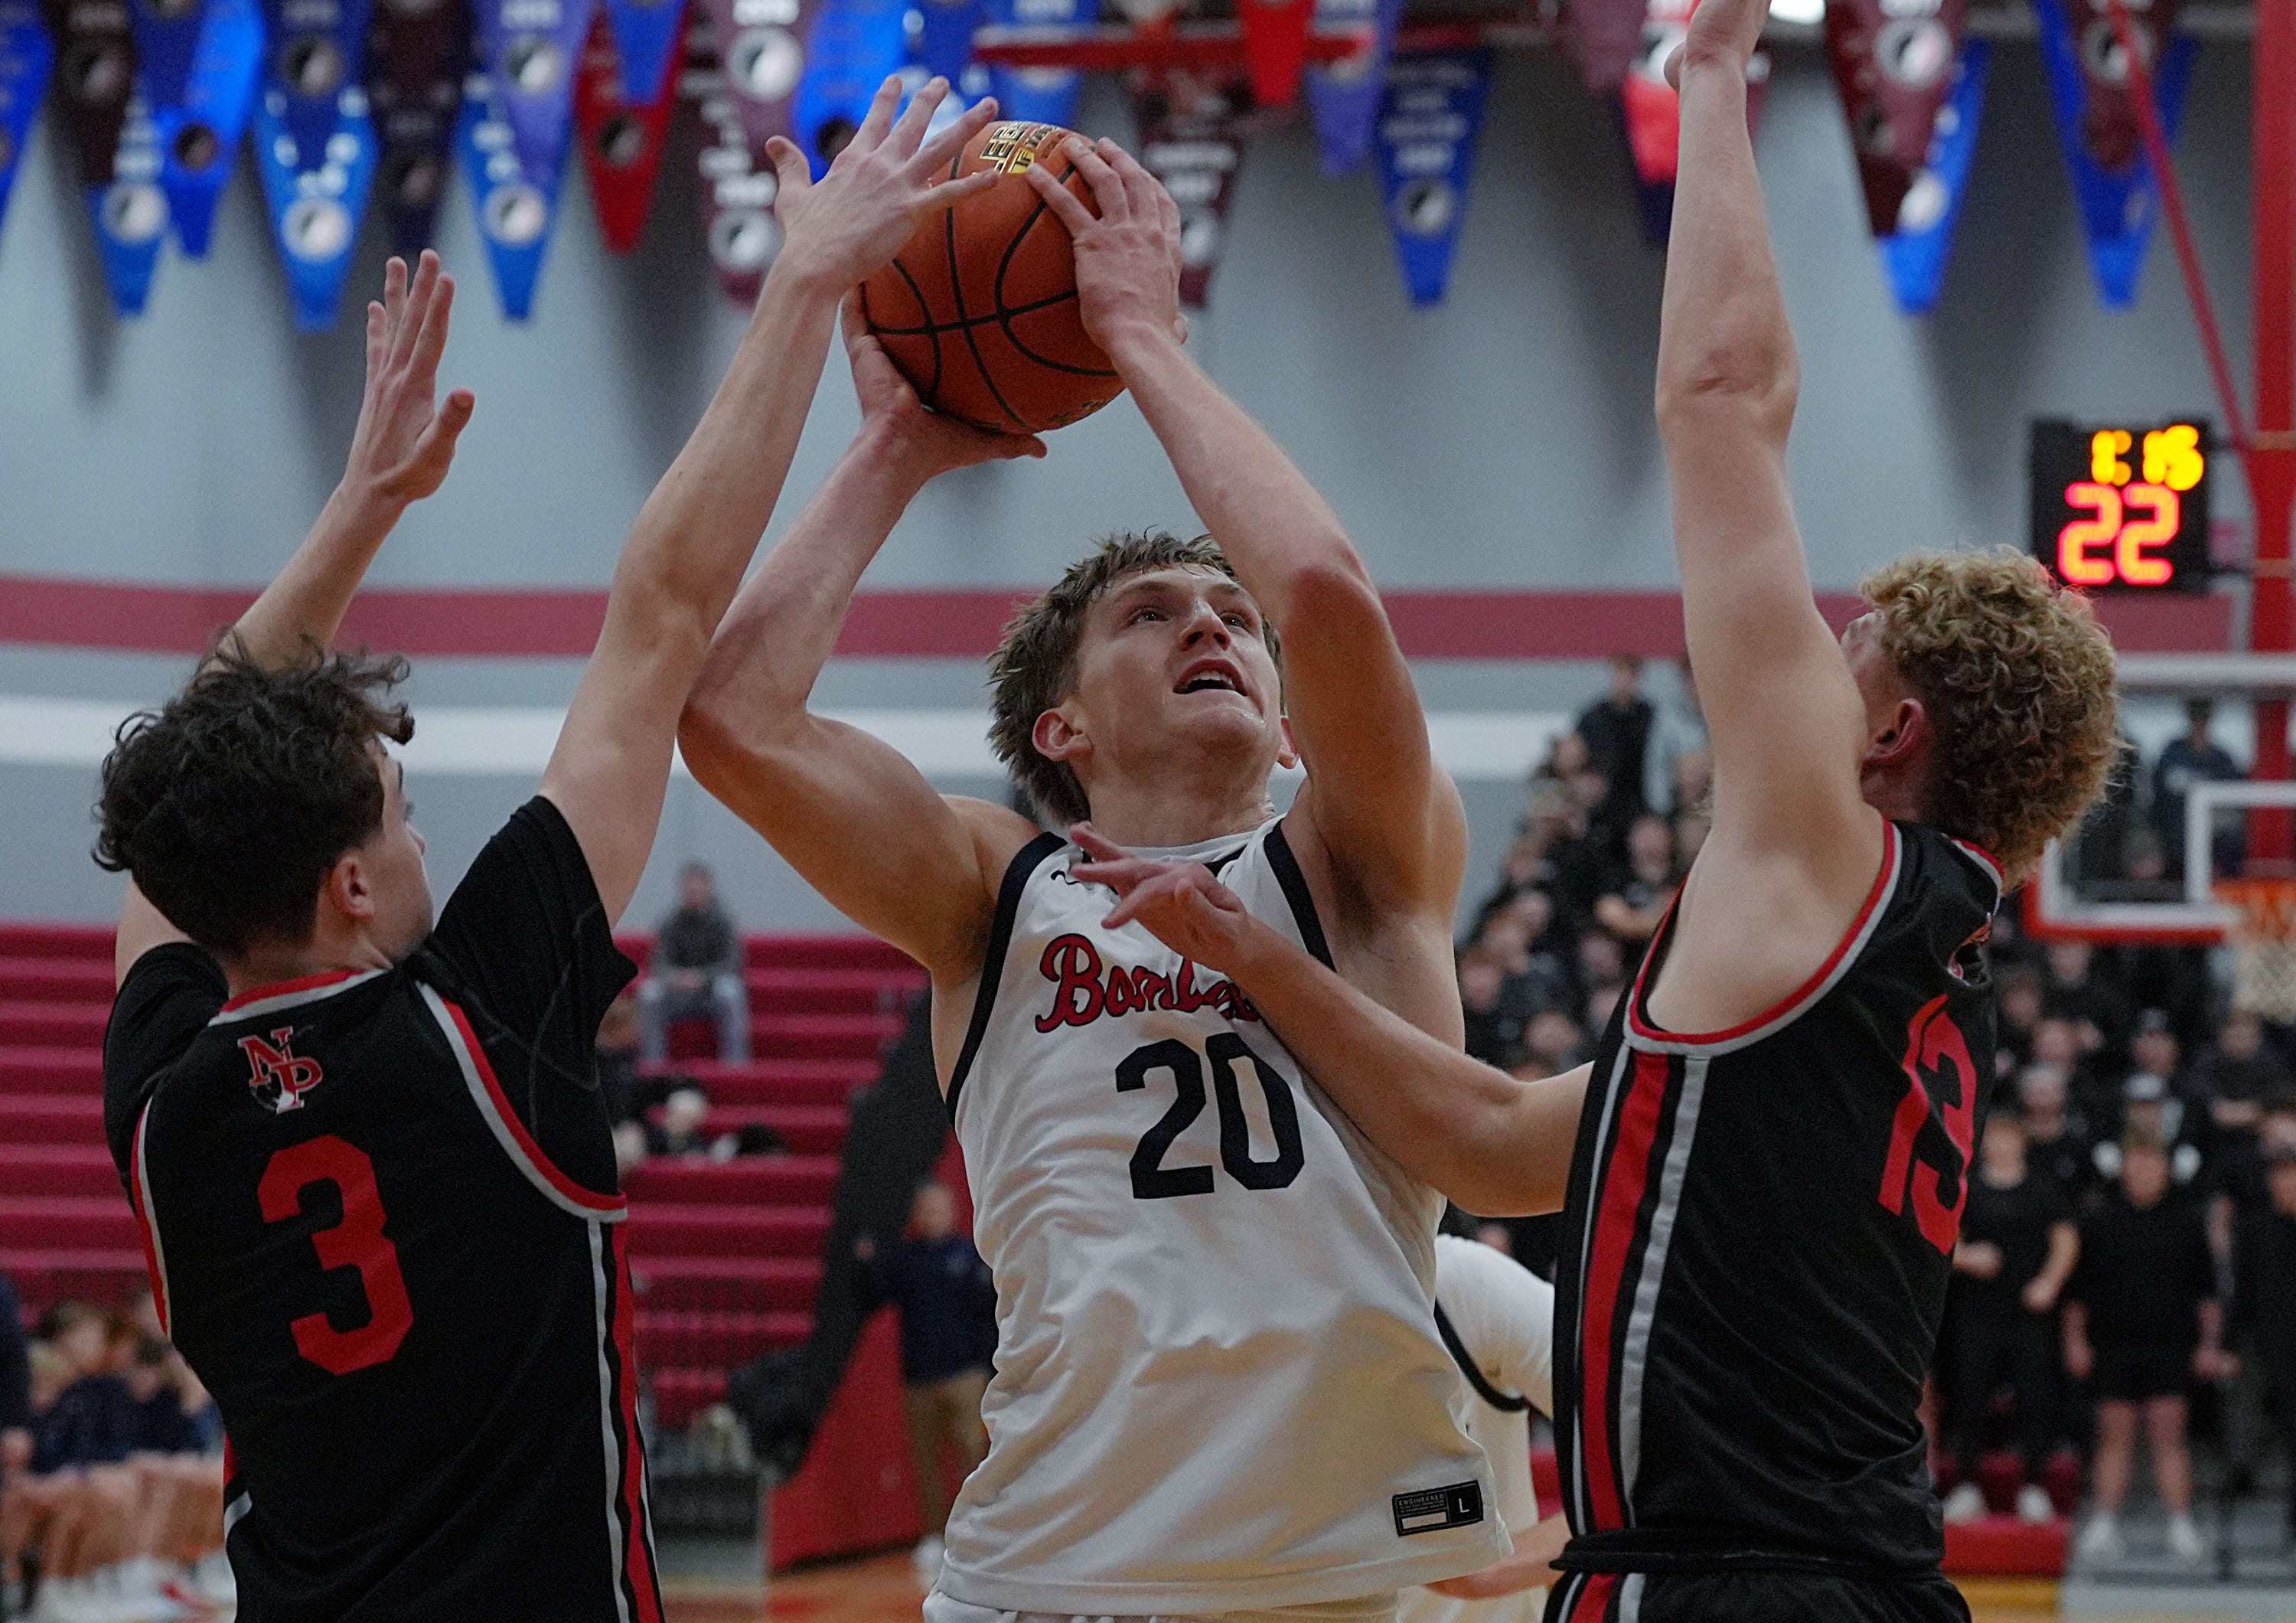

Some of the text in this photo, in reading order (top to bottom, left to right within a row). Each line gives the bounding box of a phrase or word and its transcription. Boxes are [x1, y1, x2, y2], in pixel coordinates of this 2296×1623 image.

[2092, 424, 2204, 491] 1:15
[2057, 482, 2180, 586] 22
[1115, 1031, 1305, 1199] 20
[1878, 993, 1977, 1256] 13
[256, 1134, 414, 1376] 3
[1458, 1497, 1470, 1514] L
